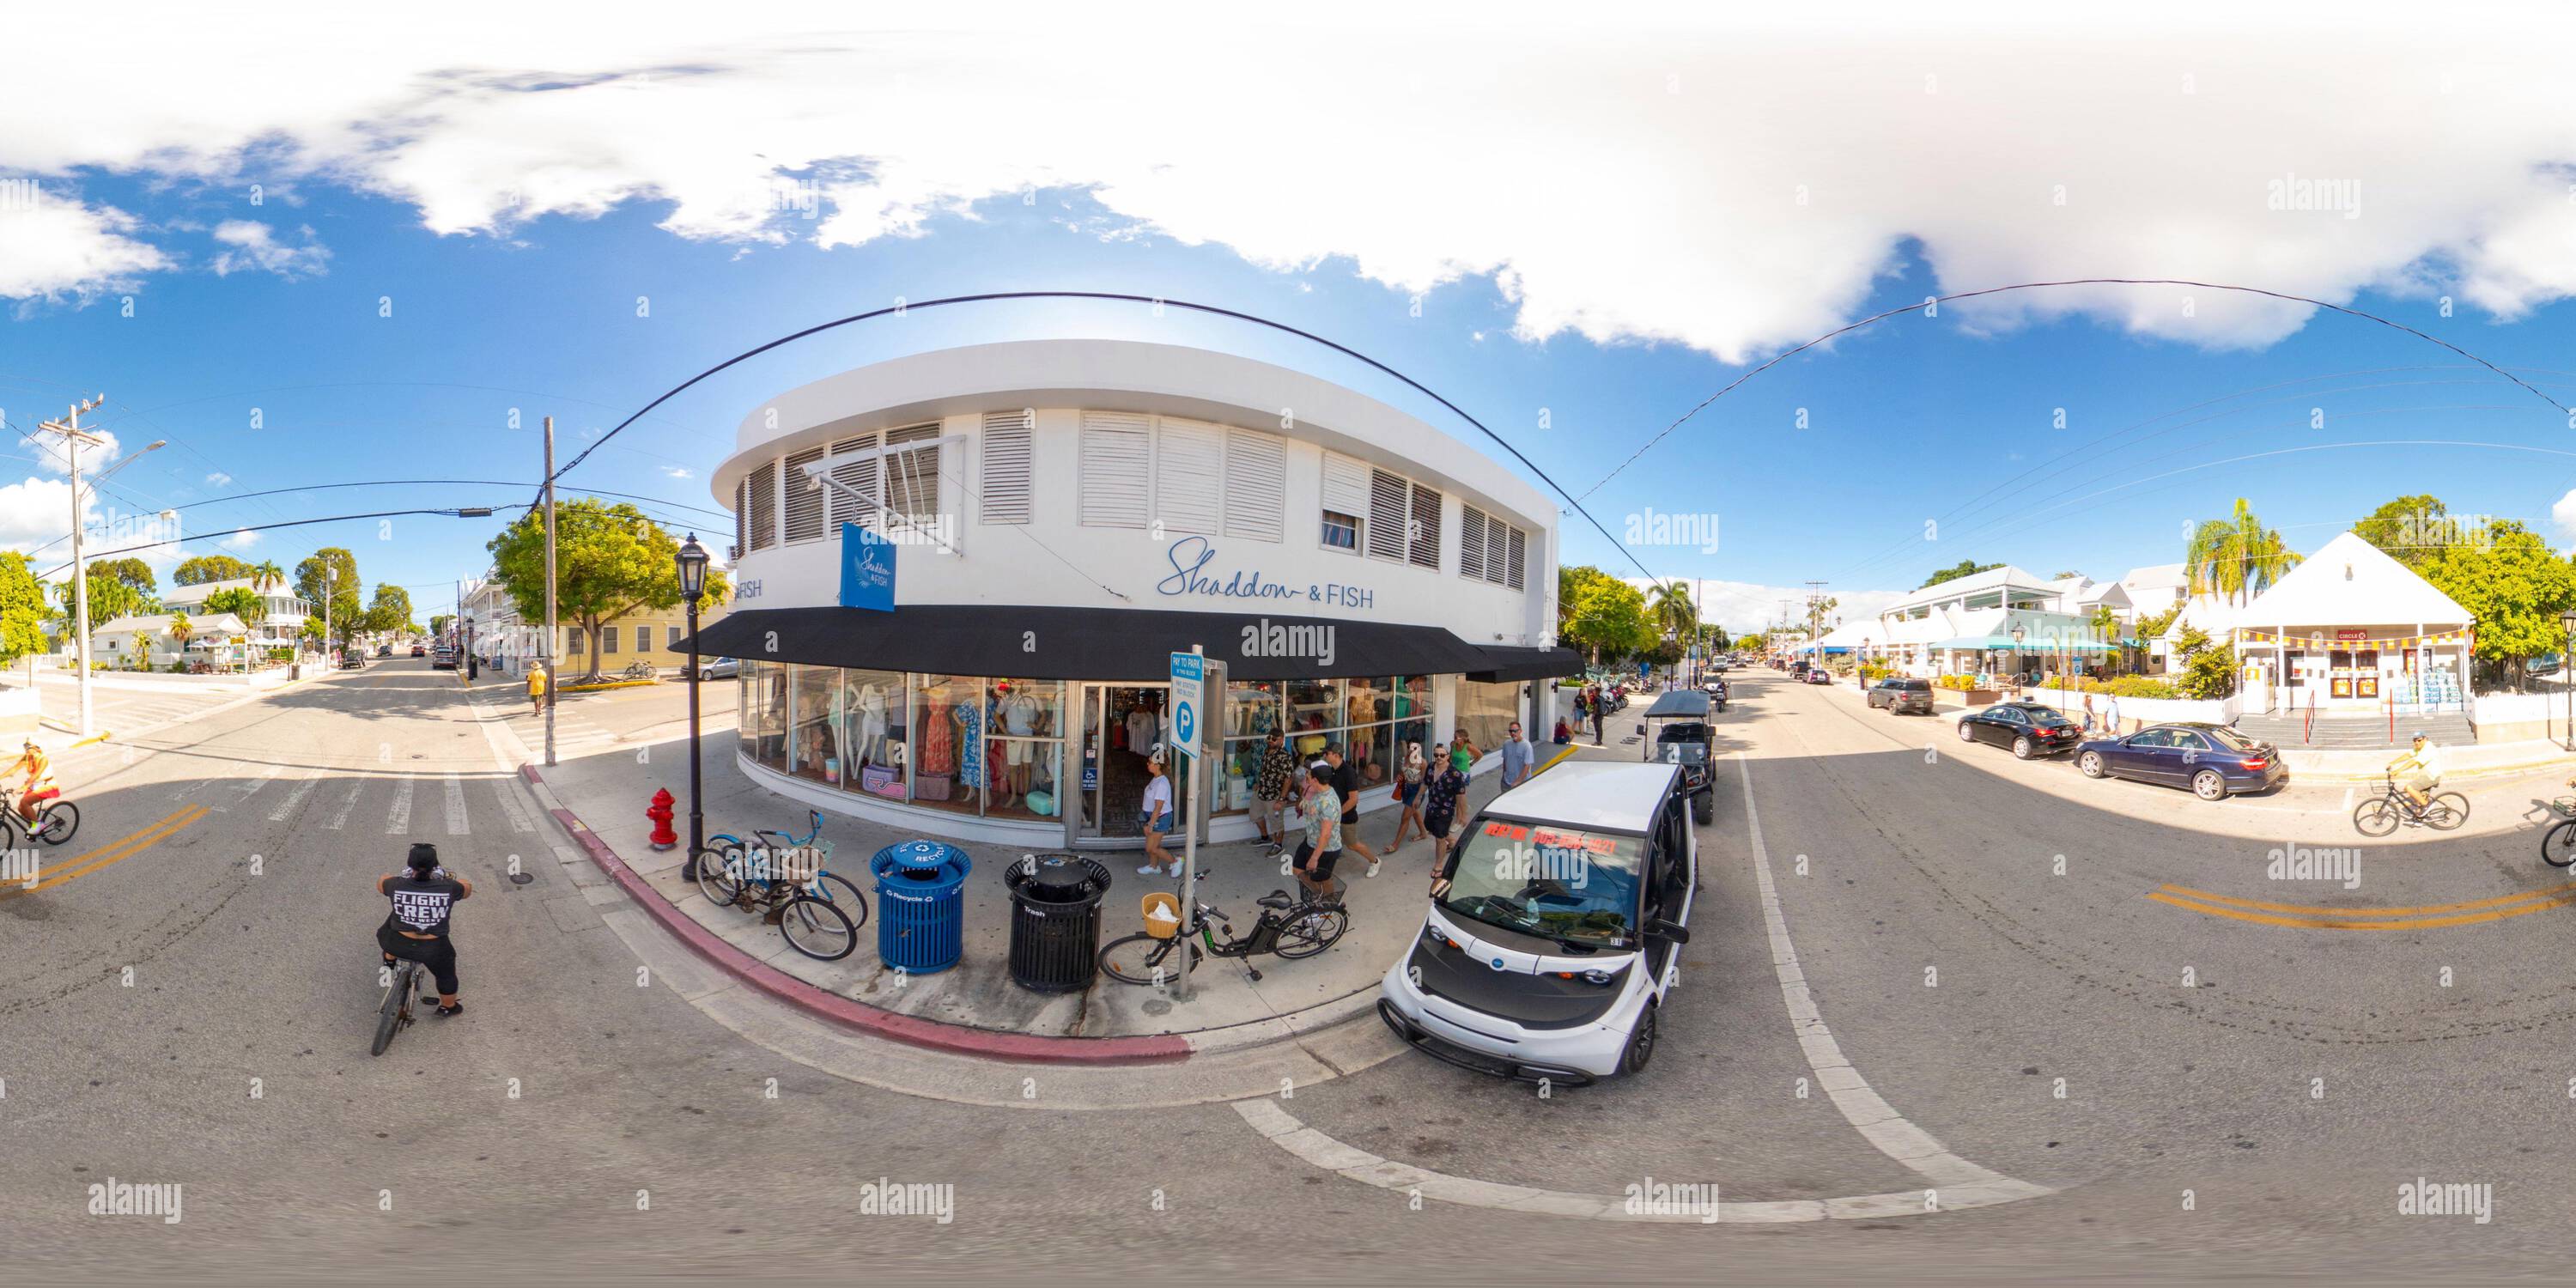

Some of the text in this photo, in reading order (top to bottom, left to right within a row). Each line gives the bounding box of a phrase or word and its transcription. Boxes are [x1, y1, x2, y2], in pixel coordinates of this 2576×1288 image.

[875, 575, 887, 587] FISH
[739, 579, 762, 599] FISH
[1309, 585, 1321, 602] &
[1327, 584, 1373, 609] FISH
[1188, 658, 1200, 670] PARK
[1181, 708, 1190, 734] P
[394, 893, 449, 906] FLIGHT
[894, 892, 923, 902] Recycle
[394, 903, 448, 919] CREW
[1024, 905, 1045, 917] Trash
